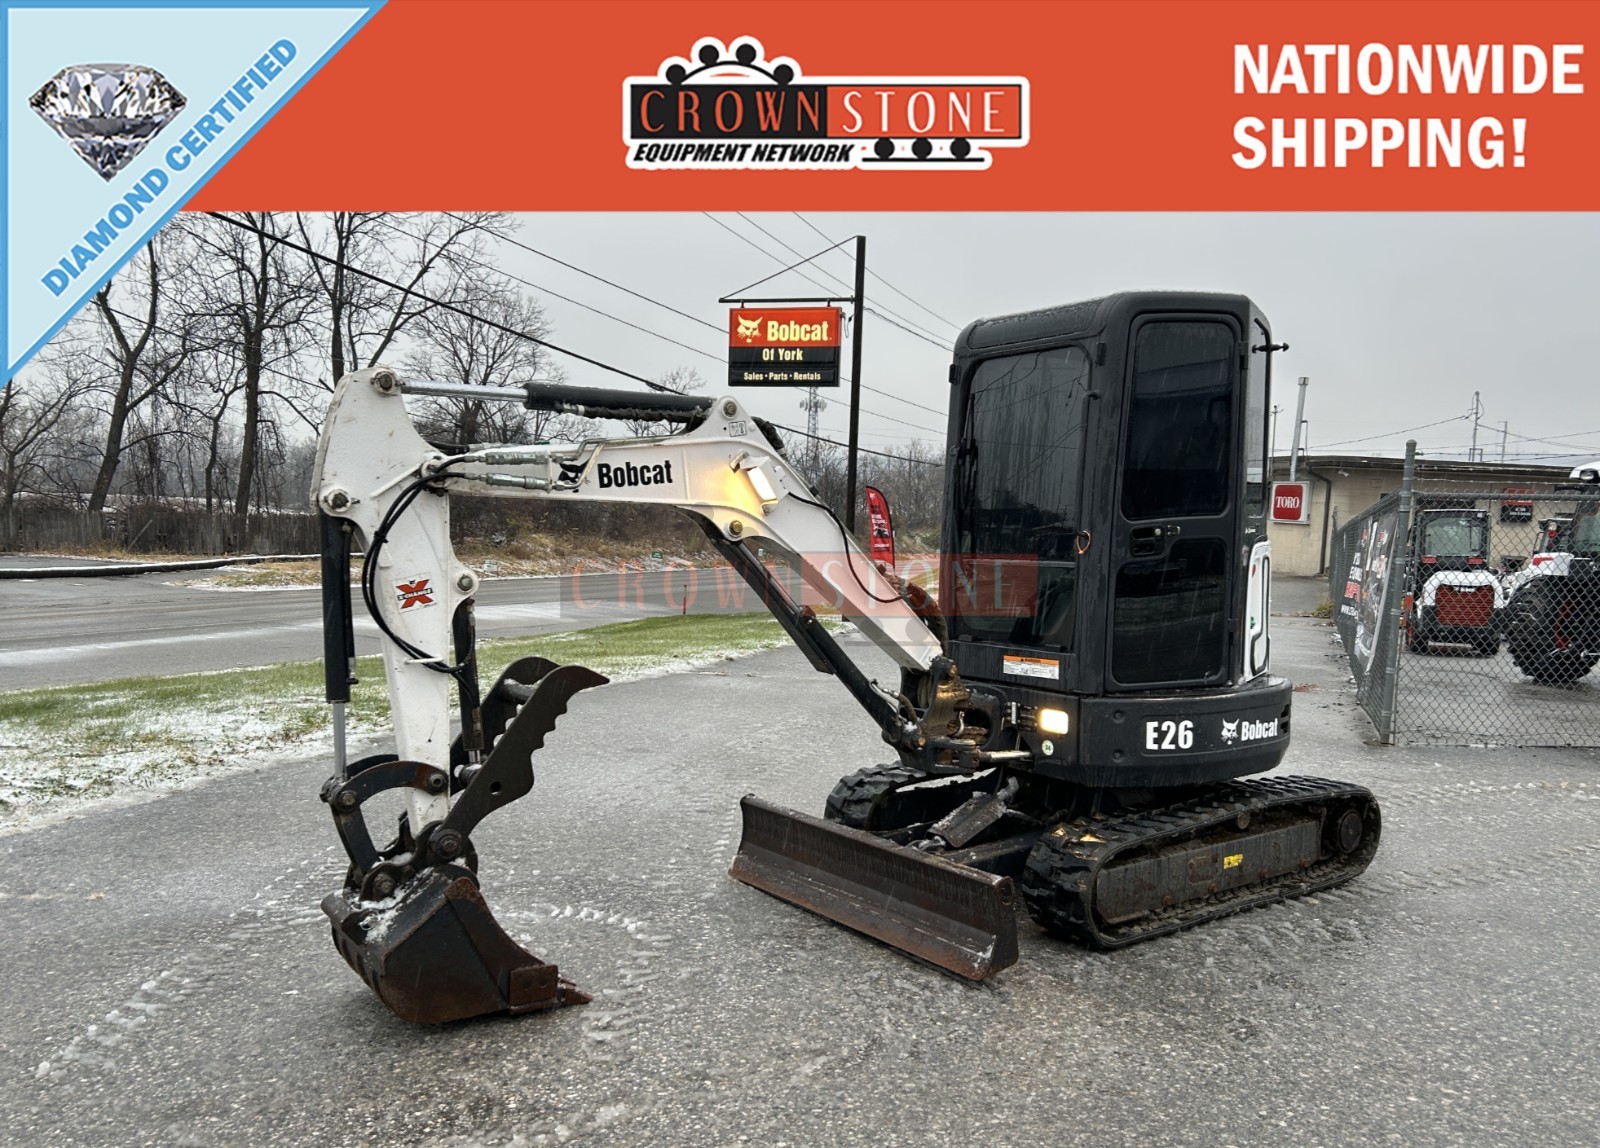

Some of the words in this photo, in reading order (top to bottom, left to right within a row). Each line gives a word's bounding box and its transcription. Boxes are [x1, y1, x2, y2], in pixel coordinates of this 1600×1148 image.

[767, 320, 828, 341] Bobcat
[762, 348, 774, 361] Of
[778, 348, 803, 361] York
[743, 372, 764, 381] Sales
[768, 372, 788, 381] Parts
[793, 371, 821, 381] Rentals
[597, 460, 673, 488] Bobcat
[1276, 496, 1300, 508] TORO
[1146, 720, 1194, 750] E26
[1241, 718, 1279, 741] Bobcat
